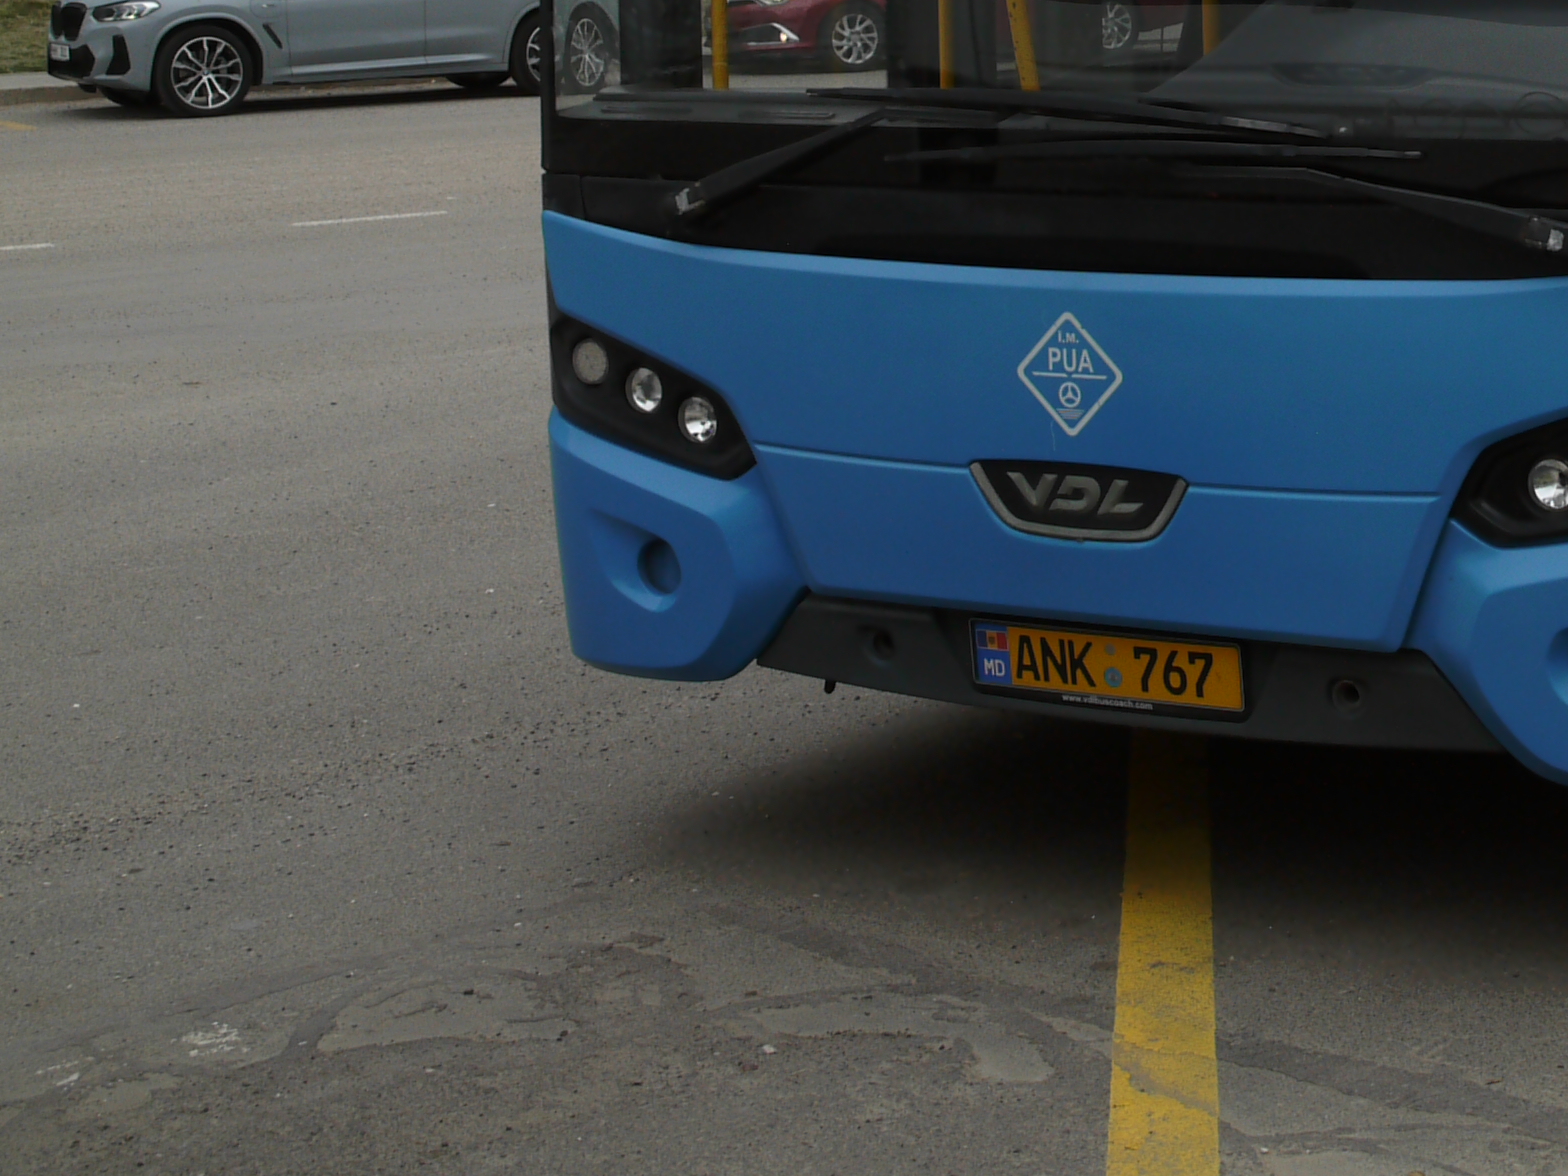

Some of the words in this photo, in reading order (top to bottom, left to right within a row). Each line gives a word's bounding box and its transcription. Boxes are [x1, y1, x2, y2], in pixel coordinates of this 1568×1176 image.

[1048, 347, 1094, 373] PUA
[1006, 471, 1144, 515] VDL
[983, 657, 1005, 677] MD
[1016, 634, 1097, 688] ANK
[1133, 645, 1214, 699] 767
